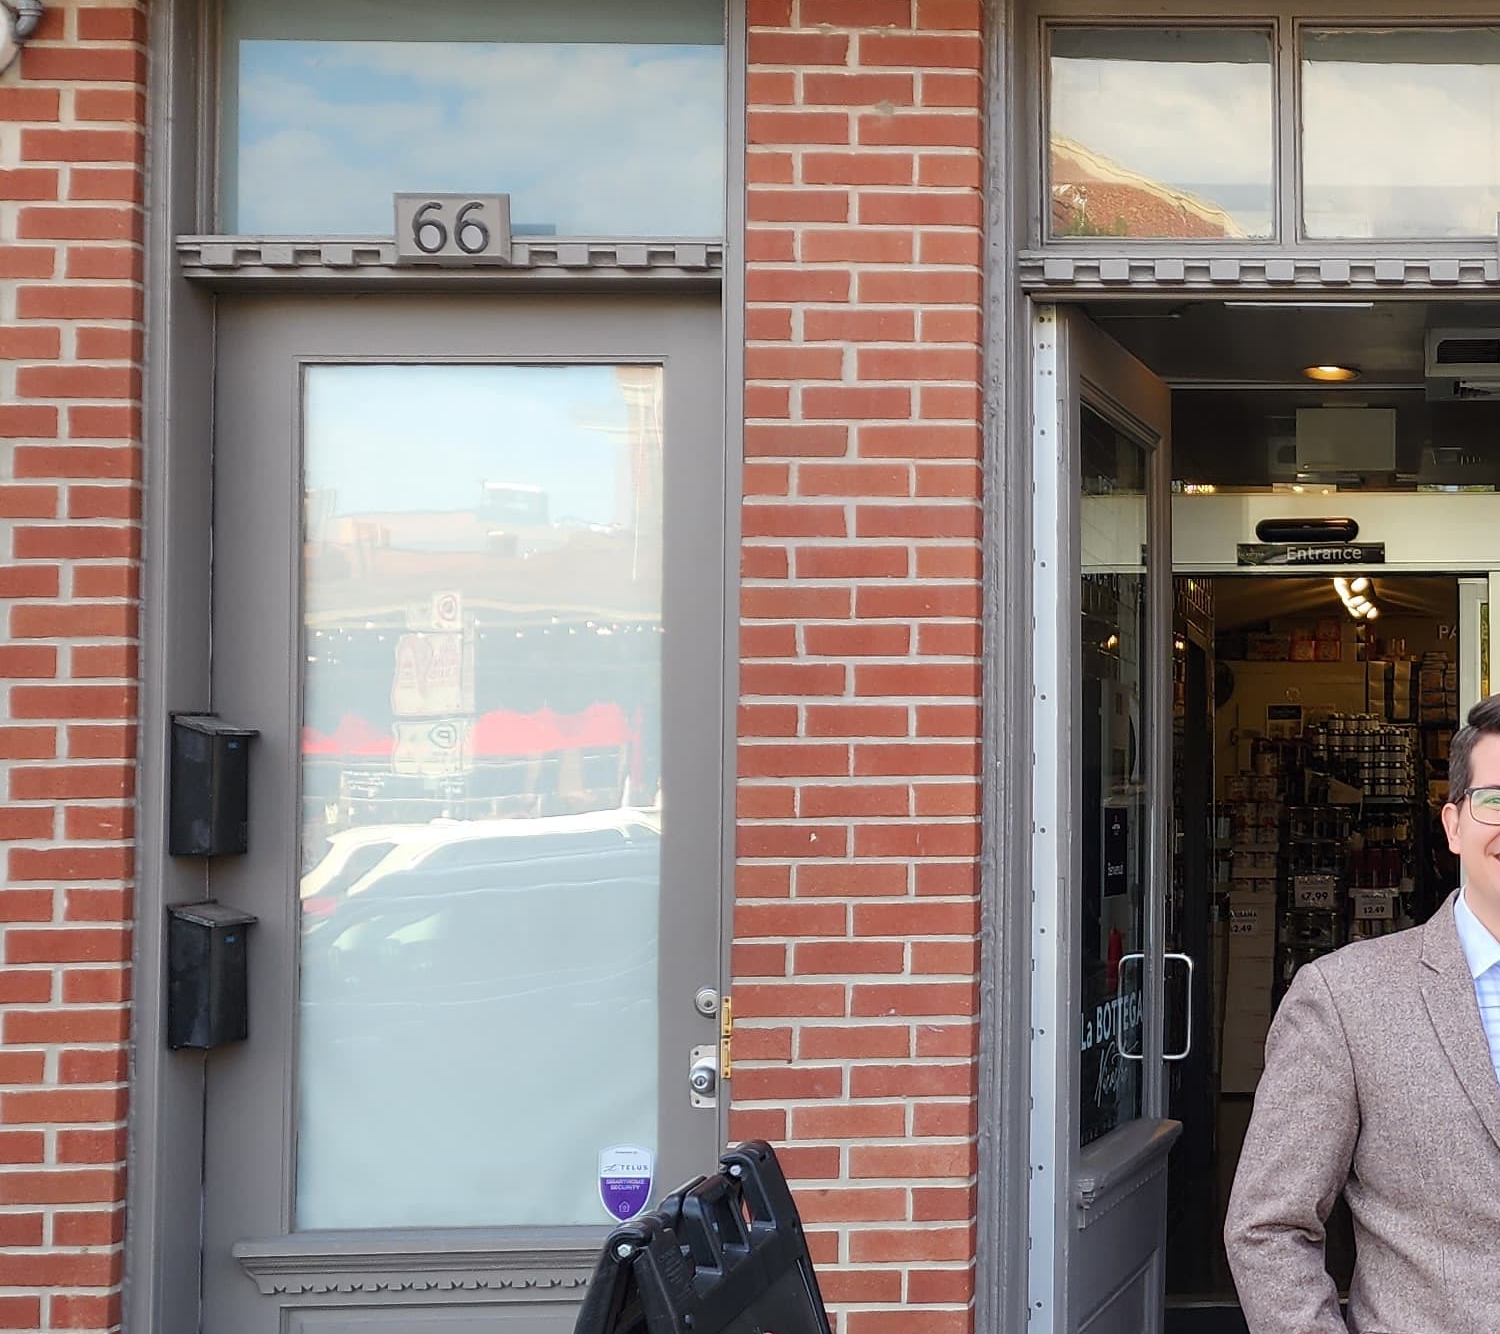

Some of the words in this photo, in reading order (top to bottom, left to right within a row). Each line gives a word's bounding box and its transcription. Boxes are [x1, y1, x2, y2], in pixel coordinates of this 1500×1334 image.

[411, 201, 489, 254] 66
[1286, 546, 1362, 561] Entrance
[1081, 1012, 1093, 1052] La
[1096, 989, 1143, 1044] BOTTEGA
